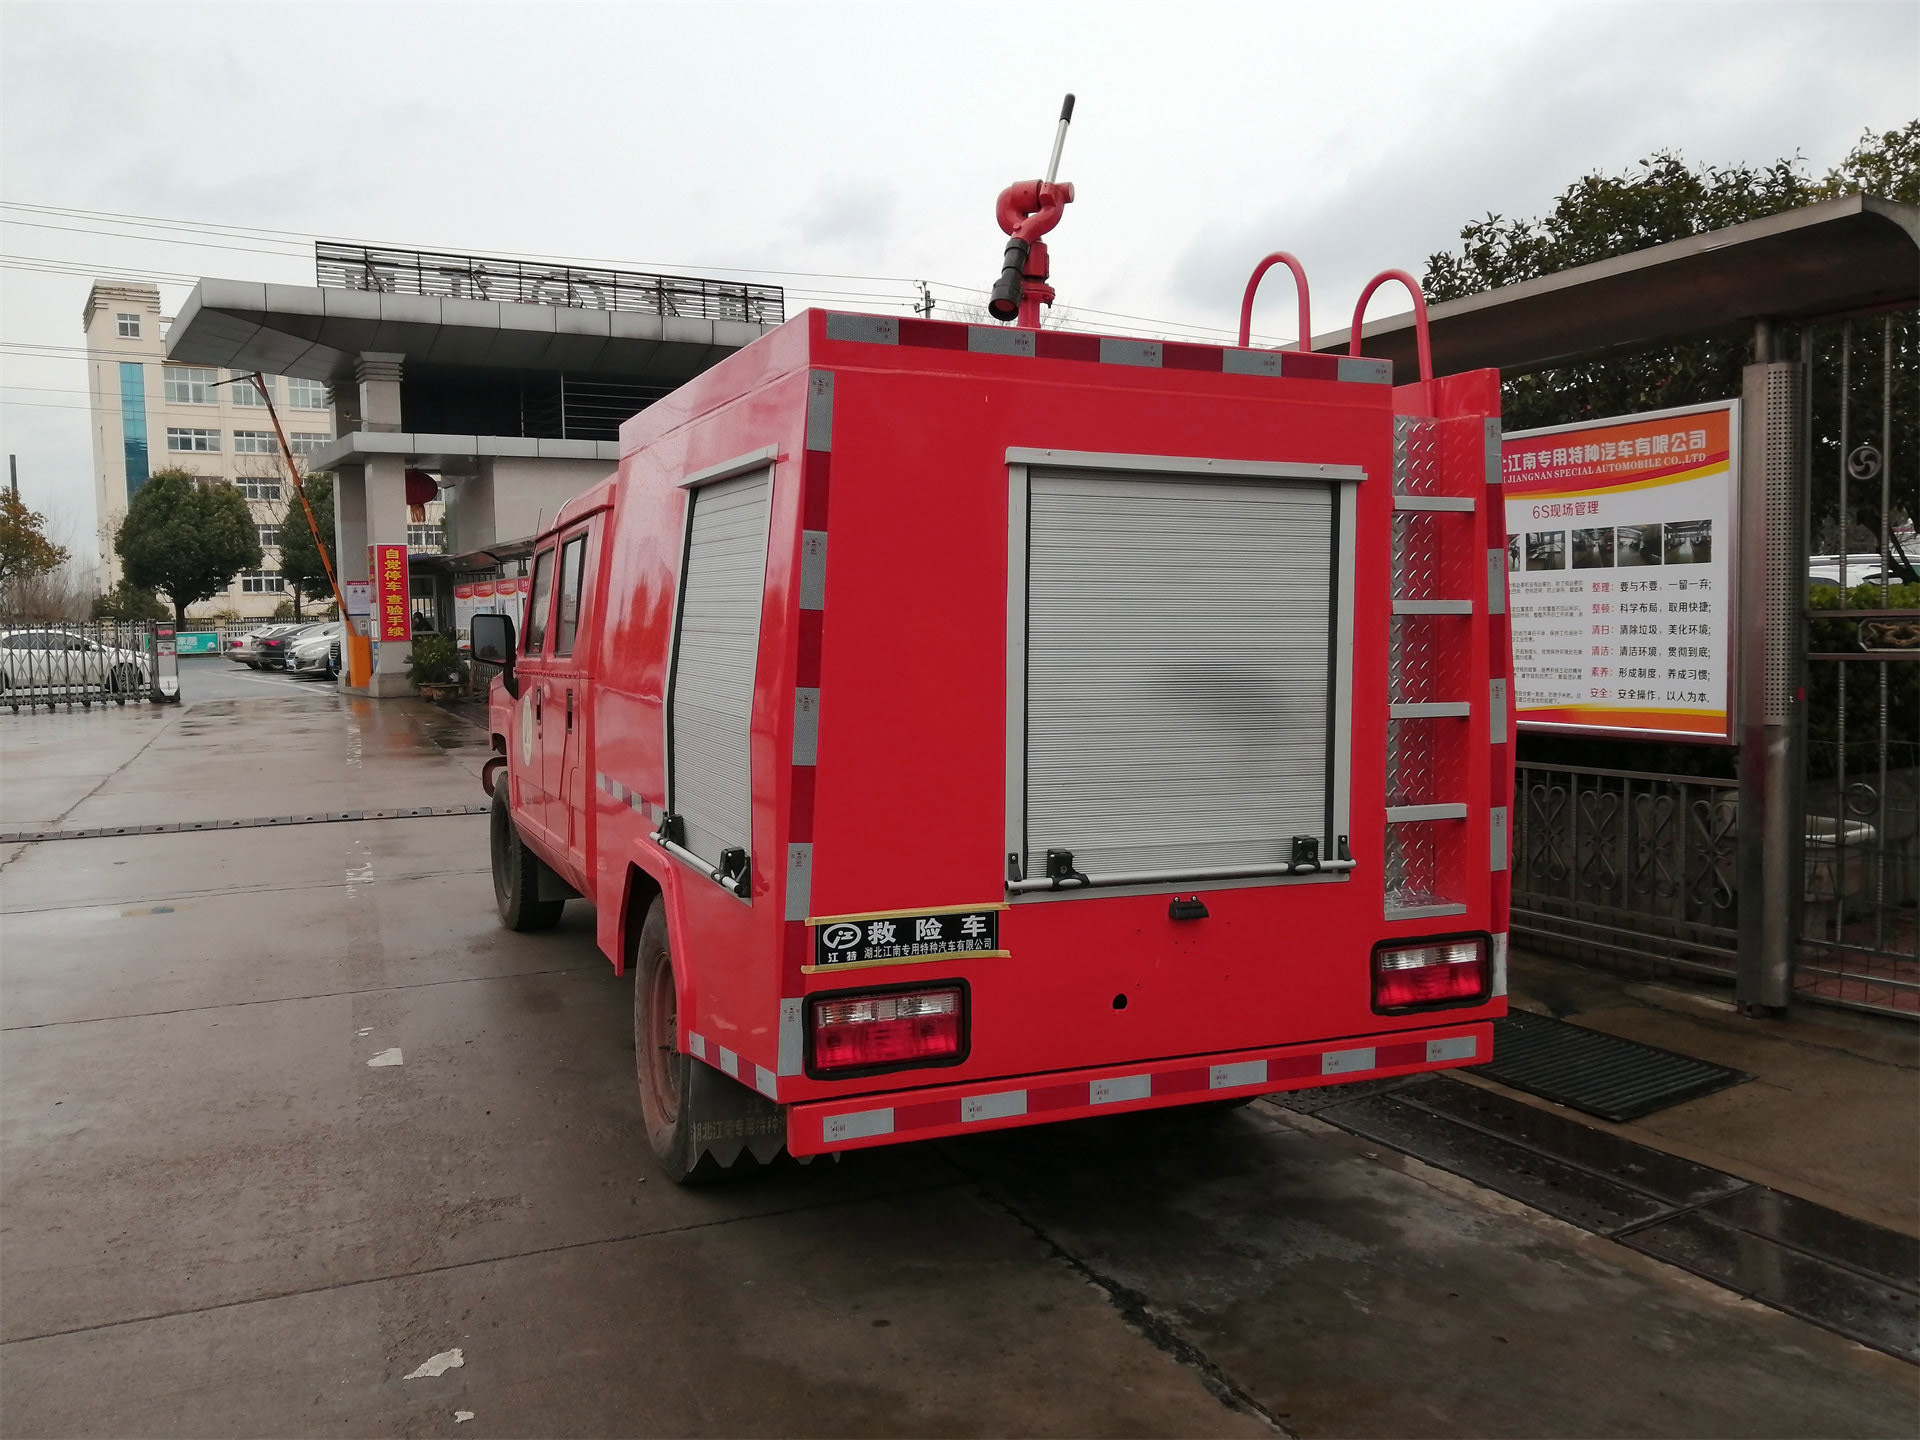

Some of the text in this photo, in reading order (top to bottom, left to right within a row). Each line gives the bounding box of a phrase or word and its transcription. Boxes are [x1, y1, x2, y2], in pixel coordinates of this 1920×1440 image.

[1507, 470, 1553, 484] JIANGNAN
[1554, 466, 1594, 478] SPECIAL
[1595, 457, 1662, 474] AUTOMOBILE
[1532, 500, 1599, 519] 6S现场管理
[867, 914, 987, 945] 救险车
[863, 937, 992, 960] 湖北江南专用特种汽车有限公司
